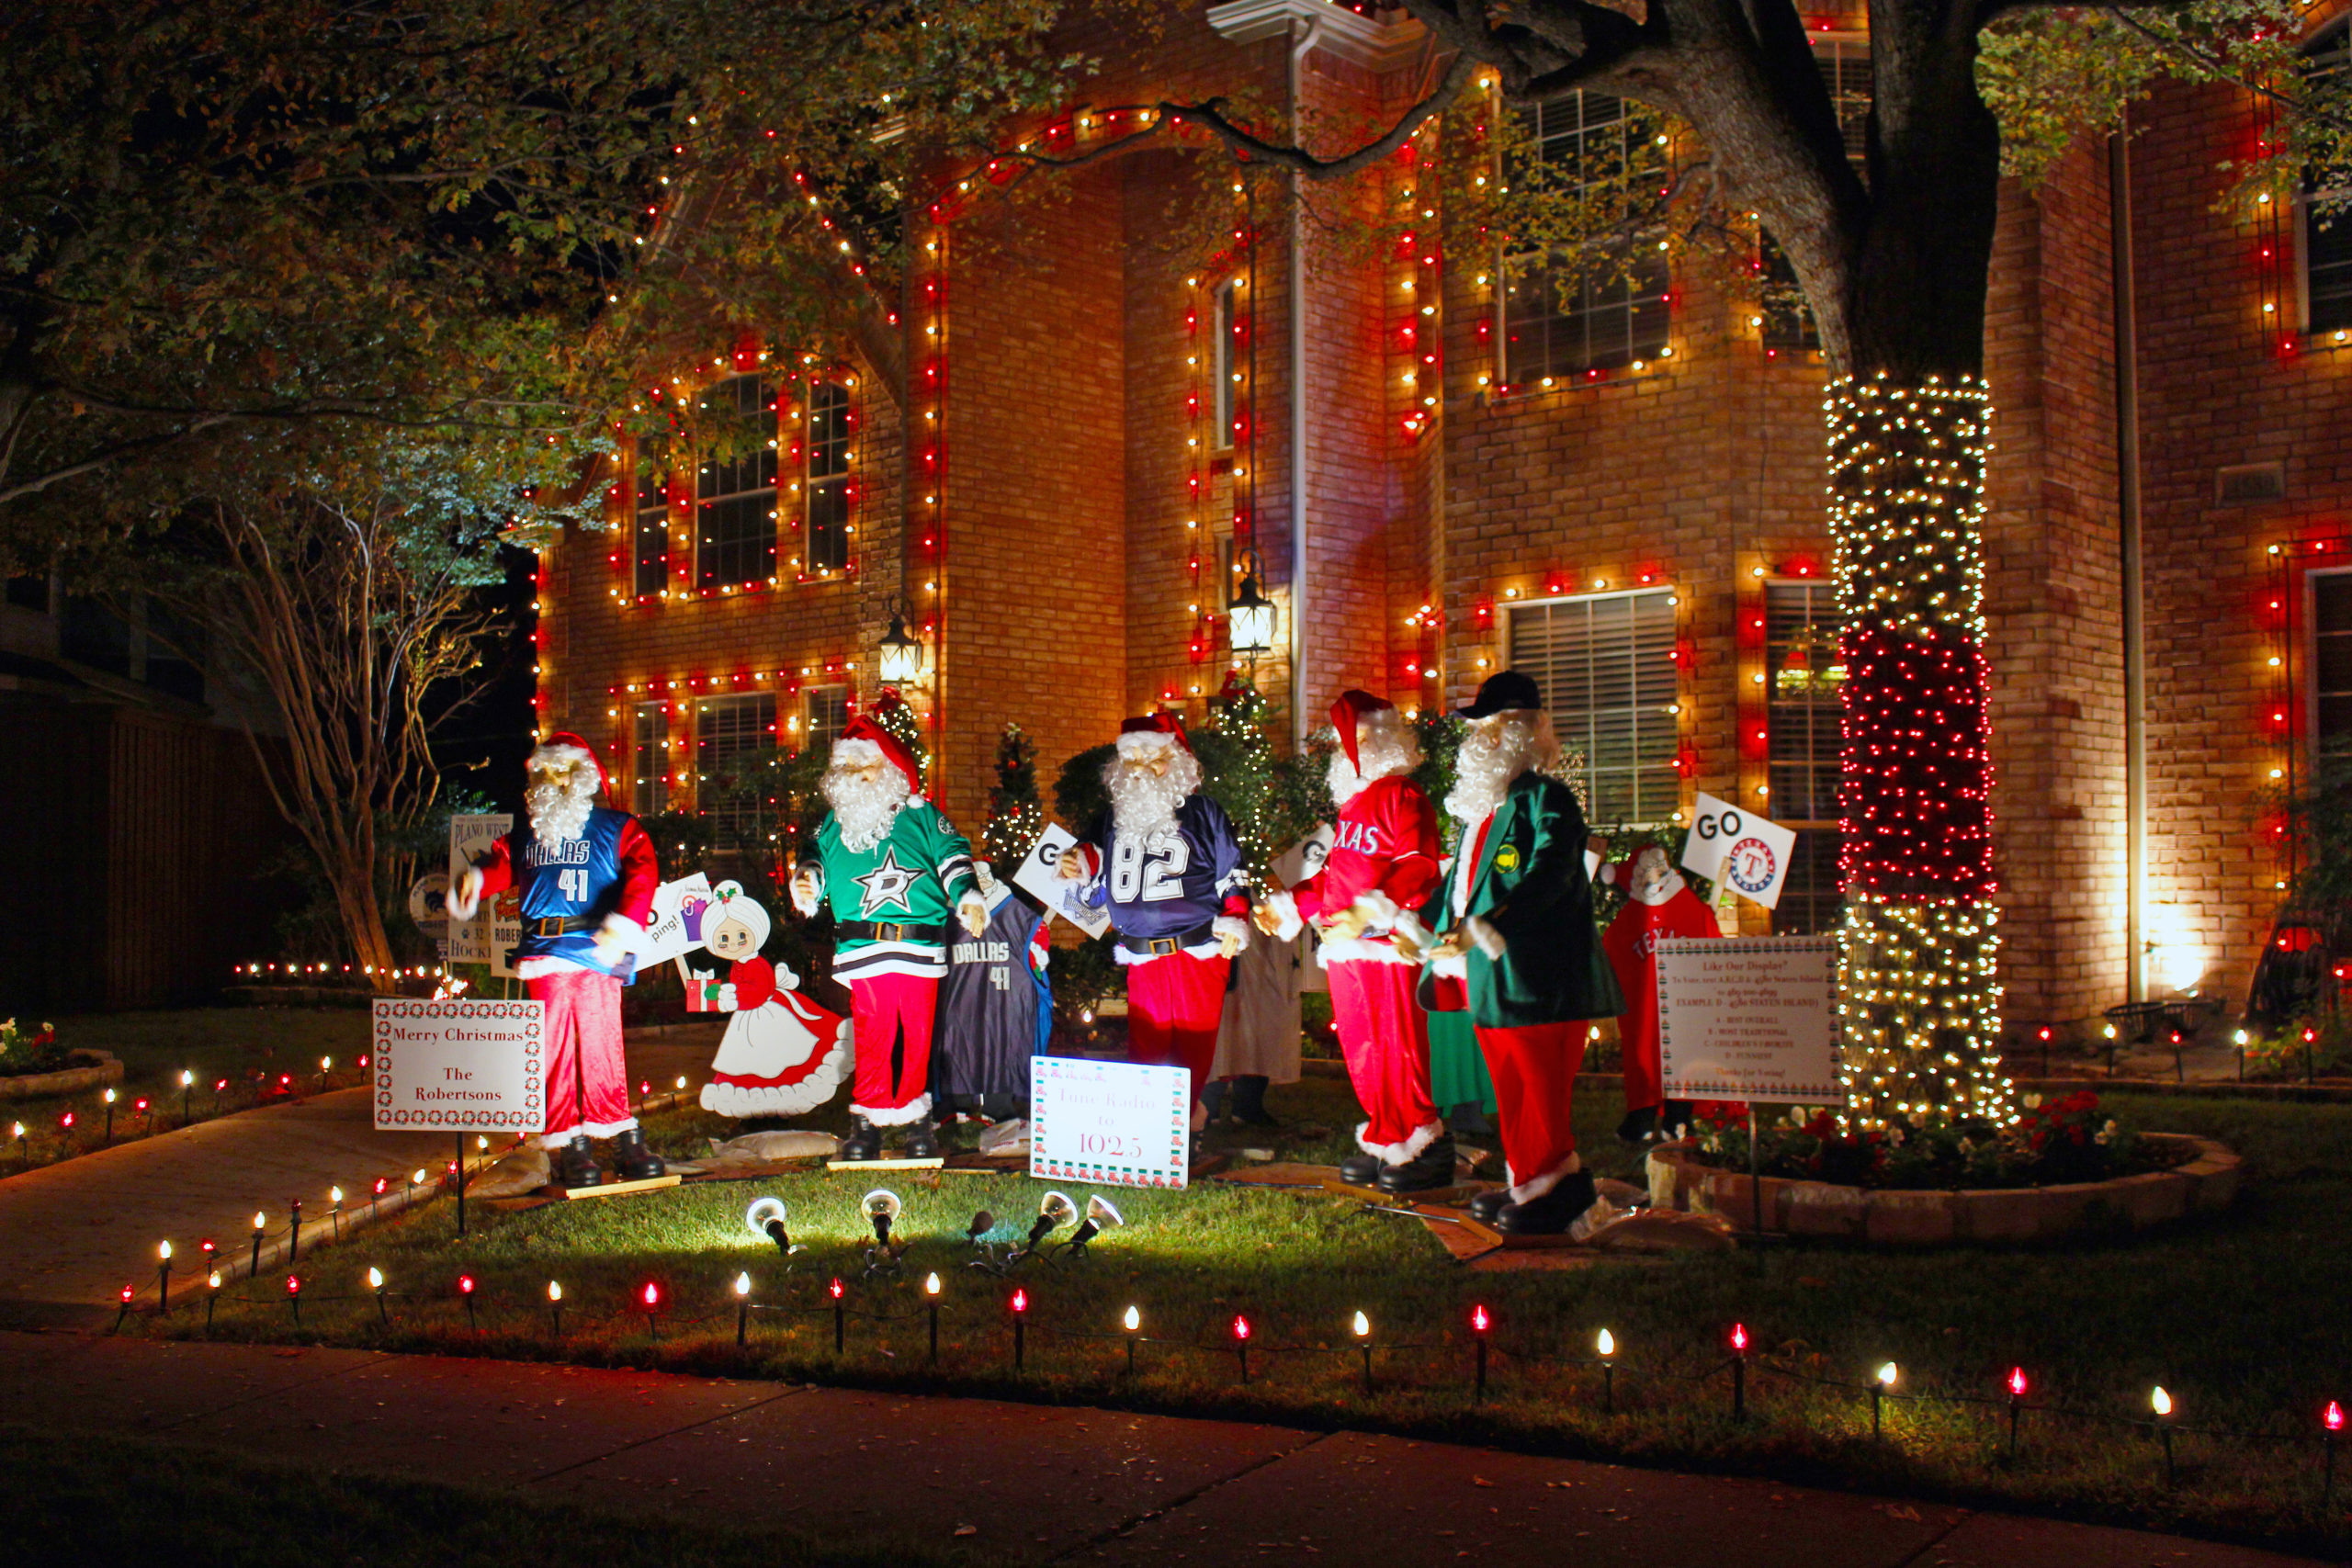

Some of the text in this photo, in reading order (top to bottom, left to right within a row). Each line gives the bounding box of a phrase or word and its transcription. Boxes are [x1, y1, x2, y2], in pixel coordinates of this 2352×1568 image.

[455, 823, 483, 849] PLANO
[1697, 811, 1742, 840] GO
[1111, 836, 1190, 904] 82
[558, 868, 589, 902] 41
[952, 942, 1010, 964] DALLAS
[1632, 927, 1687, 961] TEX
[1702, 961, 1724, 971] Like
[1725, 960, 1744, 971] Our
[989, 966, 1011, 990] 41
[392, 1028, 525, 1045] Merry Christmas
[443, 1067, 473, 1081] The
[414, 1087, 503, 1102] Robertsons
[1097, 1115, 1115, 1126] to
